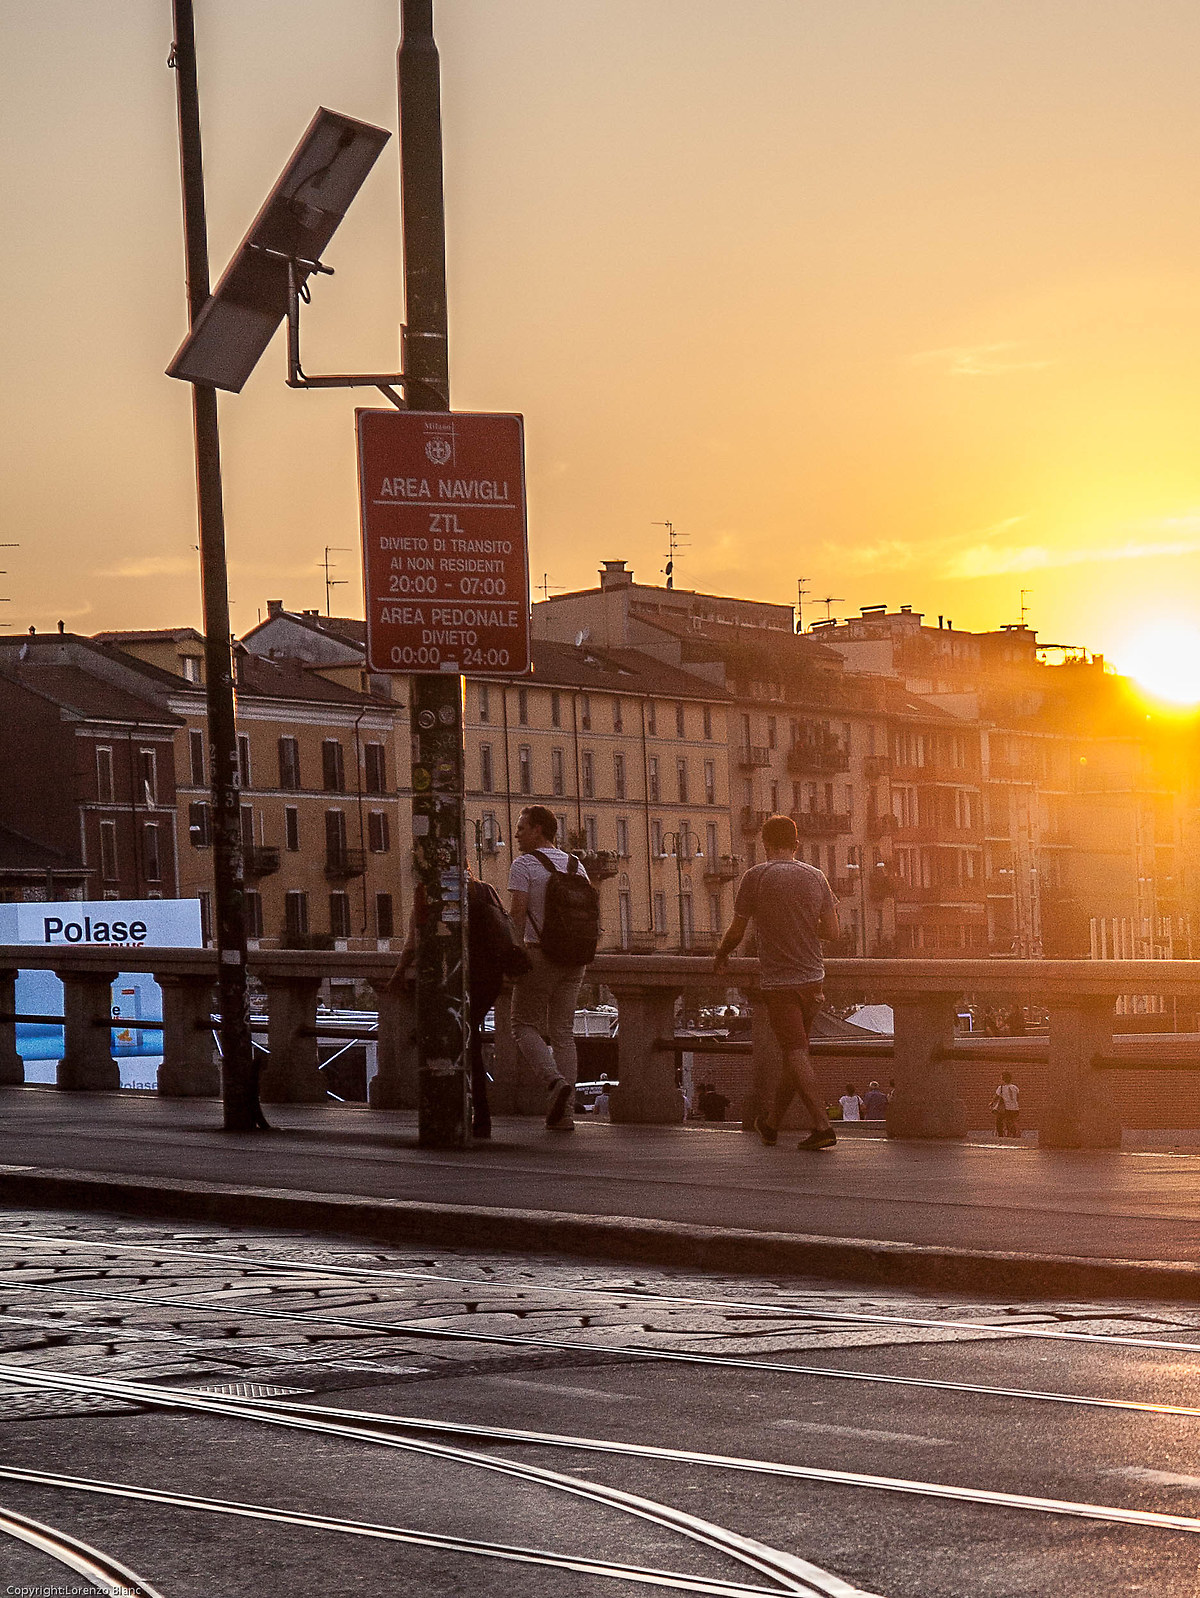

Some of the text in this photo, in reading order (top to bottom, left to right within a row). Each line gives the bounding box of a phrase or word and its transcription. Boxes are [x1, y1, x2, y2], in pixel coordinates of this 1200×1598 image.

[381, 477, 508, 500] AREA NAVIGLI
[429, 513, 464, 533] ZTL
[380, 536, 512, 554] DIVIETO DI TRANSITO
[390, 557, 504, 573] AI NON RESIDENTI
[389, 575, 437, 593] 20:00
[460, 577, 506, 596] 07:00
[380, 607, 519, 628] AREA PEDONALE
[422, 629, 477, 646] DIVIETO
[391, 646, 440, 664] 00:00
[463, 648, 510, 666] 24:00
[44, 917, 147, 942] Polase
